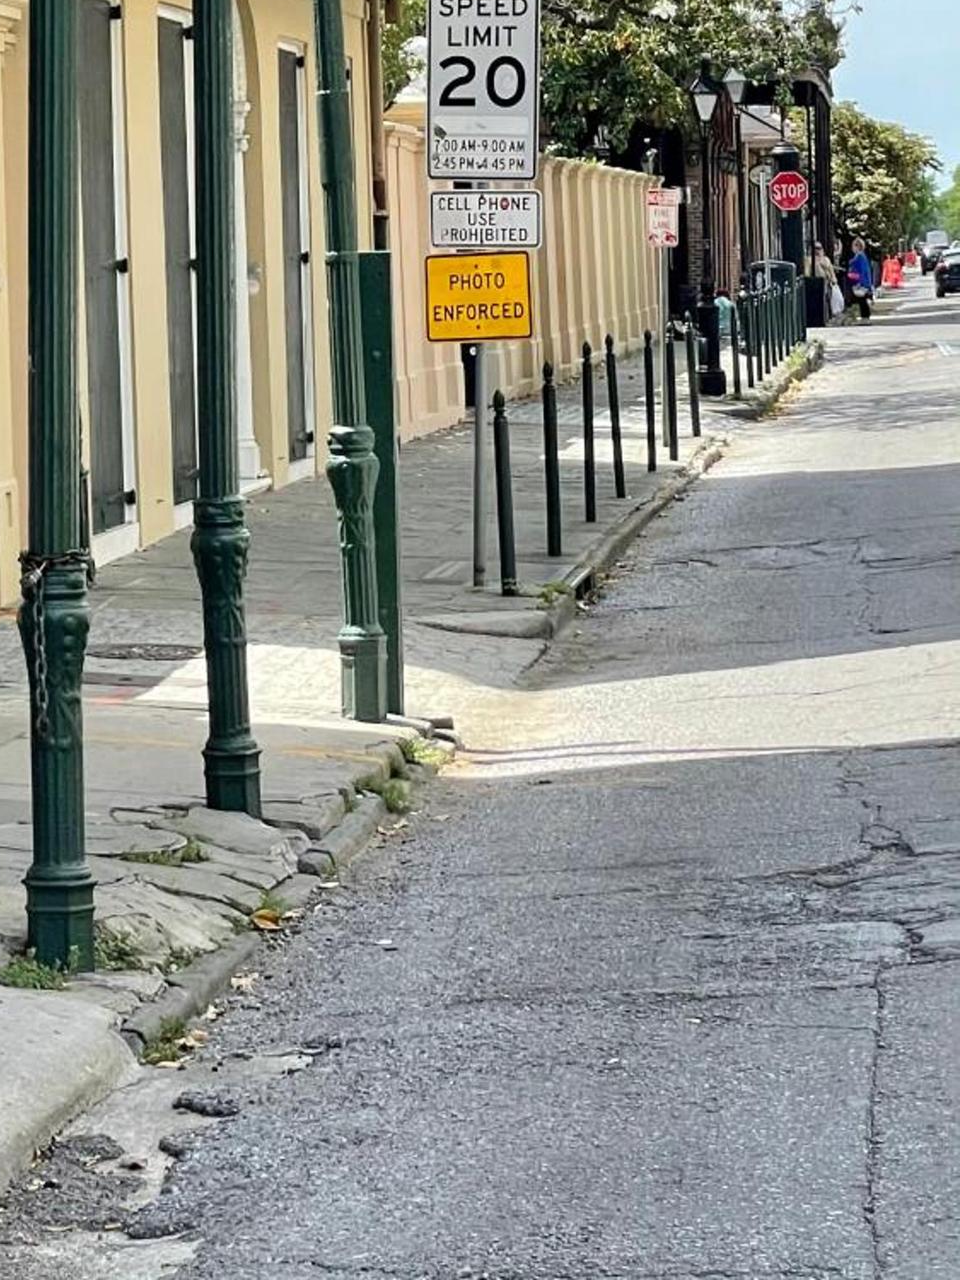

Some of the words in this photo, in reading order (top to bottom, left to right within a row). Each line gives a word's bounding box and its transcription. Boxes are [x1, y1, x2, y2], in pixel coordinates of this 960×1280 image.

[447, 25, 518, 48] LIMIT
[439, 55, 527, 108] 20
[509, 140, 526, 153] AM
[433, 156, 457, 170] 245
[508, 158, 525, 171] PM
[772, 183, 806, 201] STOP
[438, 196, 472, 211] CELL
[477, 194, 531, 211] PHONE
[467, 212, 497, 227] USE
[440, 227, 529, 242] PROHIBITED
[448, 271, 506, 291] PHOTO
[432, 301, 525, 322] ENFORCED
